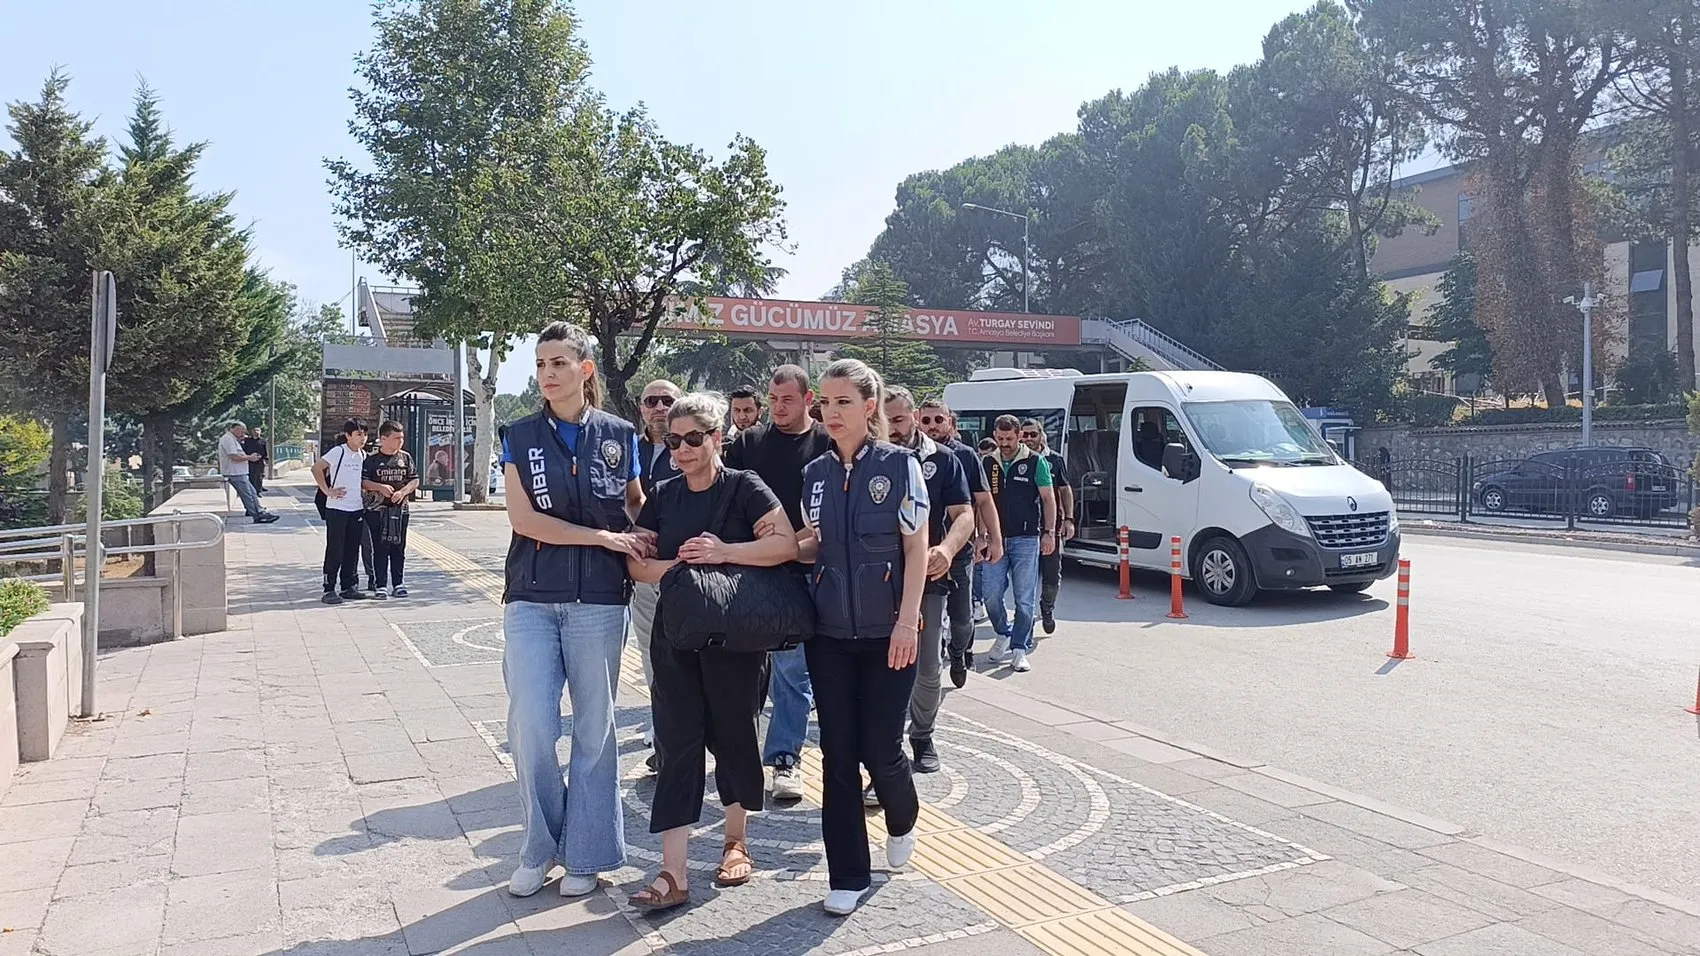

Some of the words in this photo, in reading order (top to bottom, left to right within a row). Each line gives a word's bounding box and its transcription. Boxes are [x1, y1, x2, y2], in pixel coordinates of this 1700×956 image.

[731, 301, 857, 332] GÜCÜMÜZ
[862, 312, 960, 336] AASYA
[1017, 320, 1055, 330] SEVİNDİ
[979, 328, 1004, 338] Amasya
[1005, 330, 1032, 339] Belediye
[527, 447, 553, 510] SIBER
